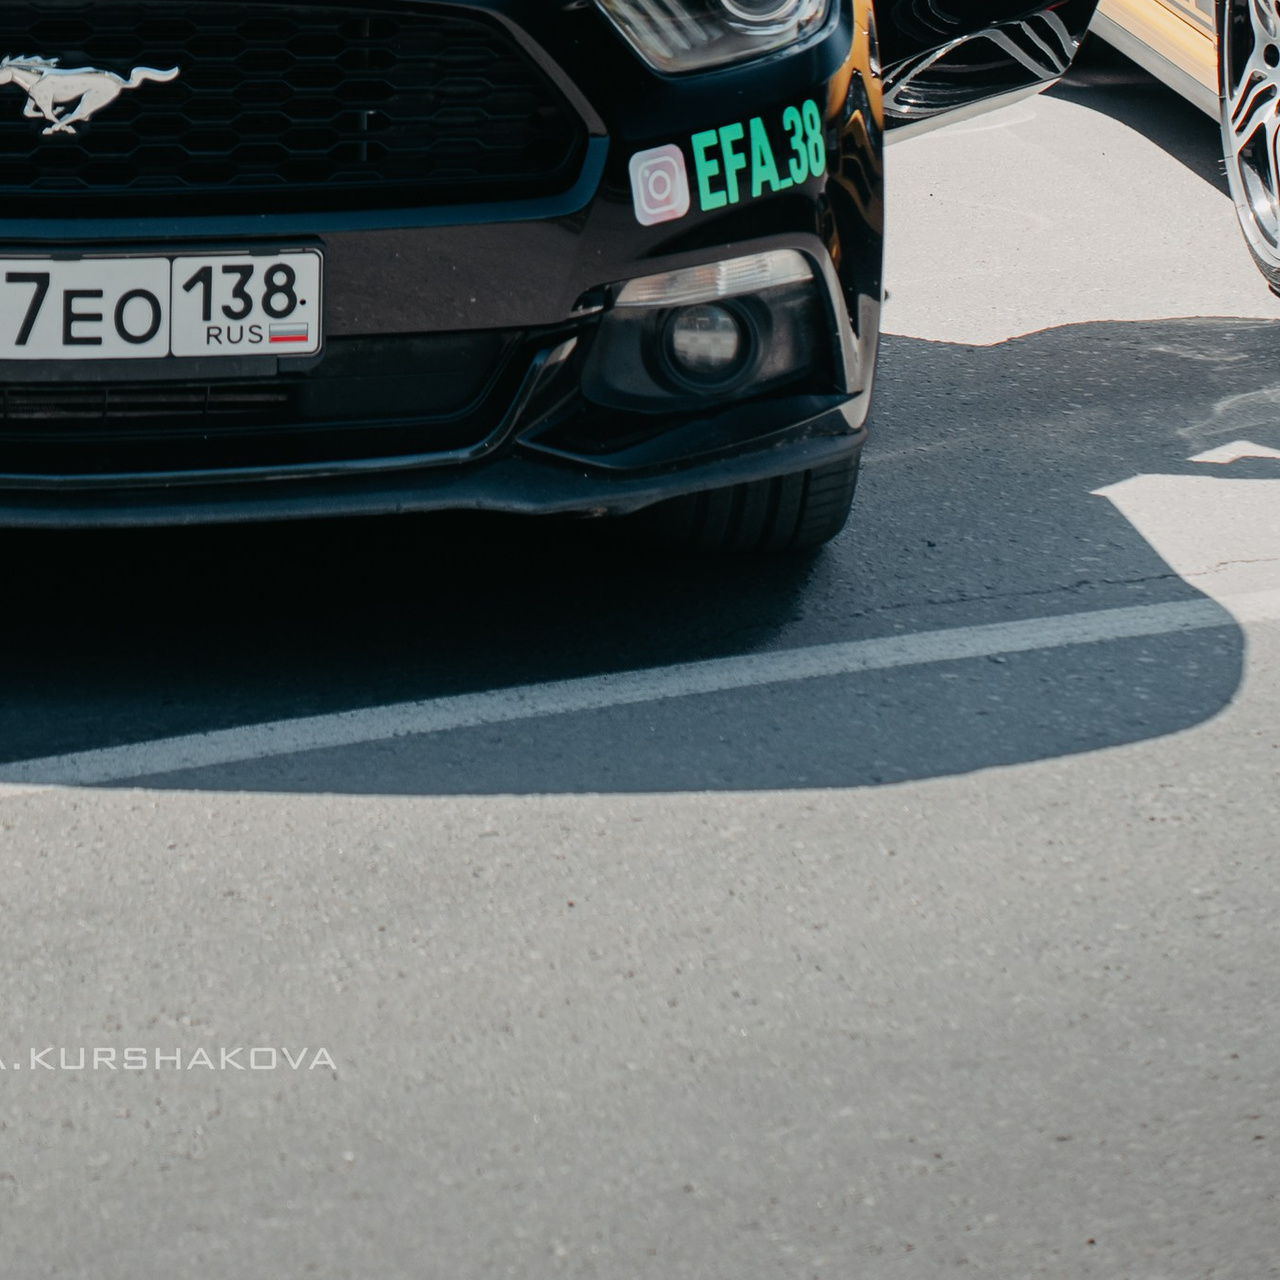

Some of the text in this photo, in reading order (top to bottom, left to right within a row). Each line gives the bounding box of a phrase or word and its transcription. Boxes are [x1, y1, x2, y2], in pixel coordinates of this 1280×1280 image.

[691, 99, 826, 212] EFA_38
[182, 263, 298, 321] 138
[206, 324, 264, 345] RUS
